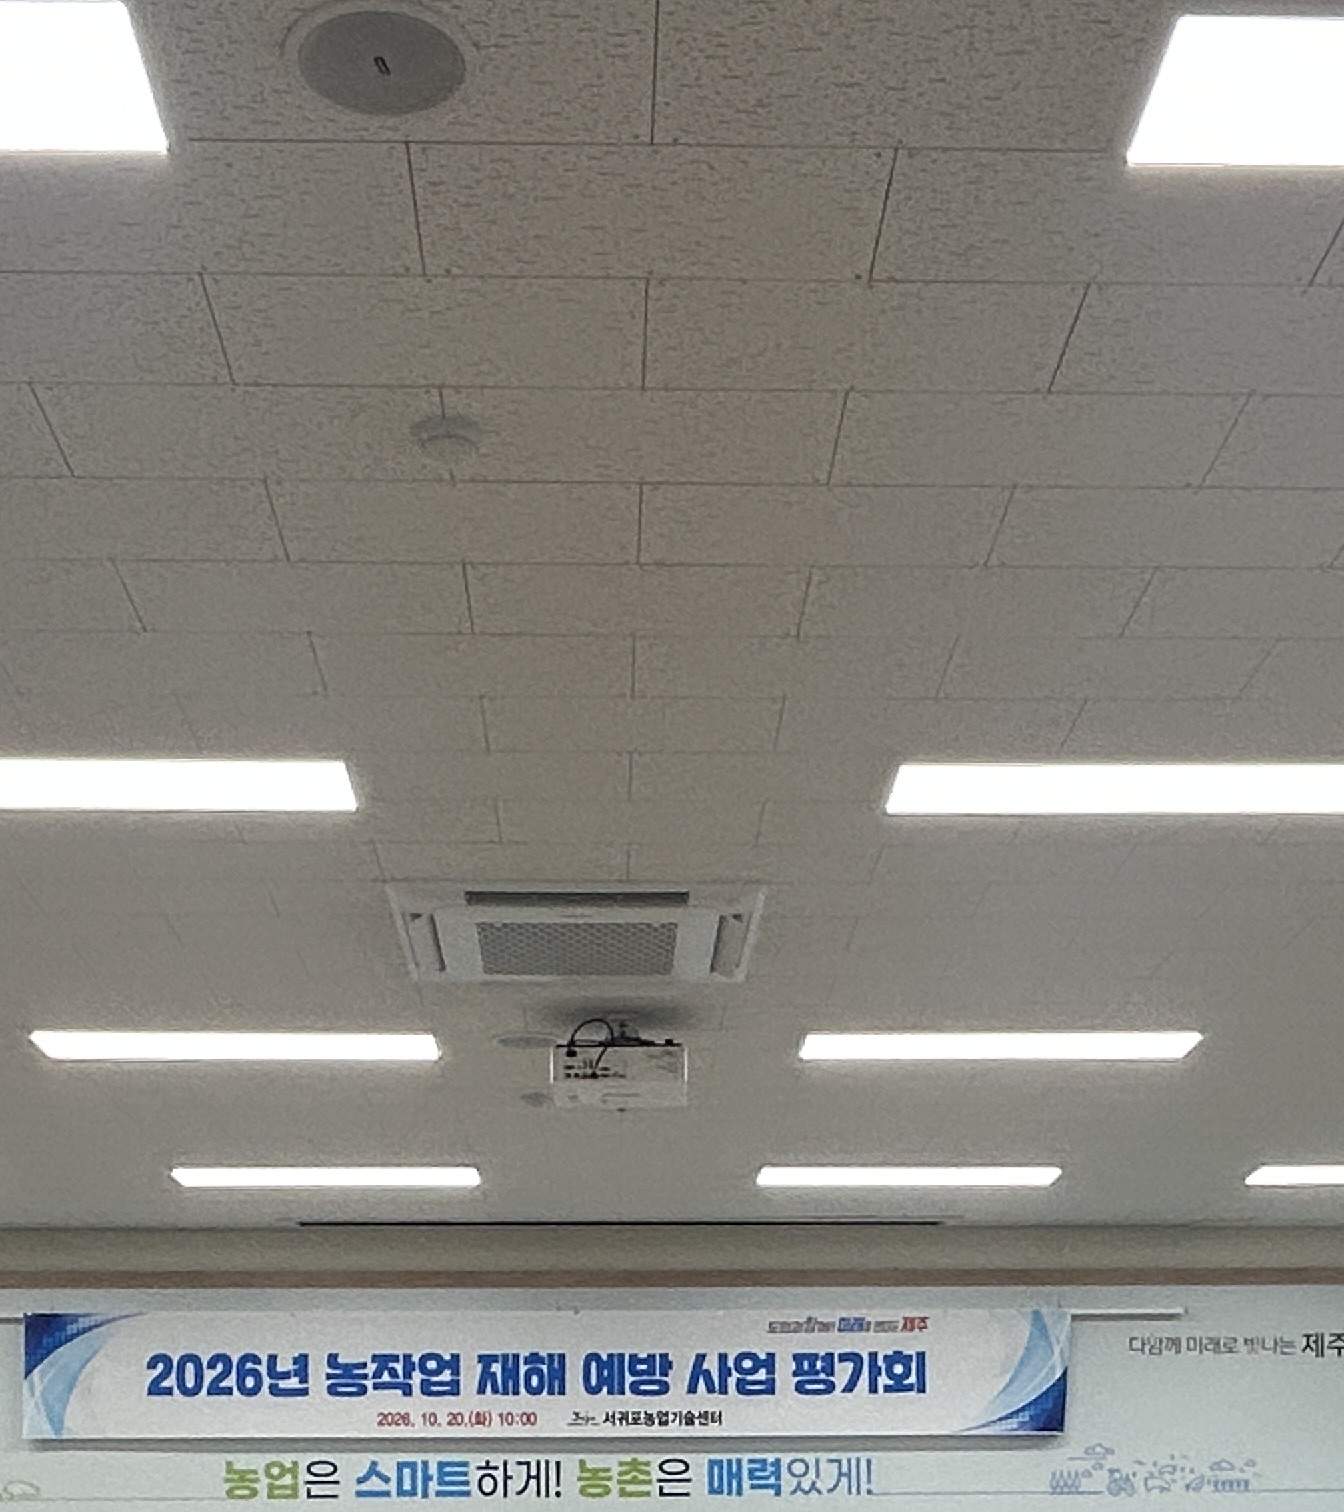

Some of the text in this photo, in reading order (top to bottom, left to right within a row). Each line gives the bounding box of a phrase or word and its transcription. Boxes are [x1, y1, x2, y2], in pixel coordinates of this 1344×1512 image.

[1186, 1336, 1239, 1355] 미래로
[146, 1350, 927, 1398] 2026년 농작업 재해 예방 사업 평가회
[376, 1412, 416, 1428] 2026.
[421, 1412, 442, 1428] 10.
[498, 1412, 538, 1427] 10:00
[602, 1410, 723, 1428] 서귀포농업기술센터
[223, 1456, 874, 1500] 농업은 스마트하게! 농촌은 매력있게!
